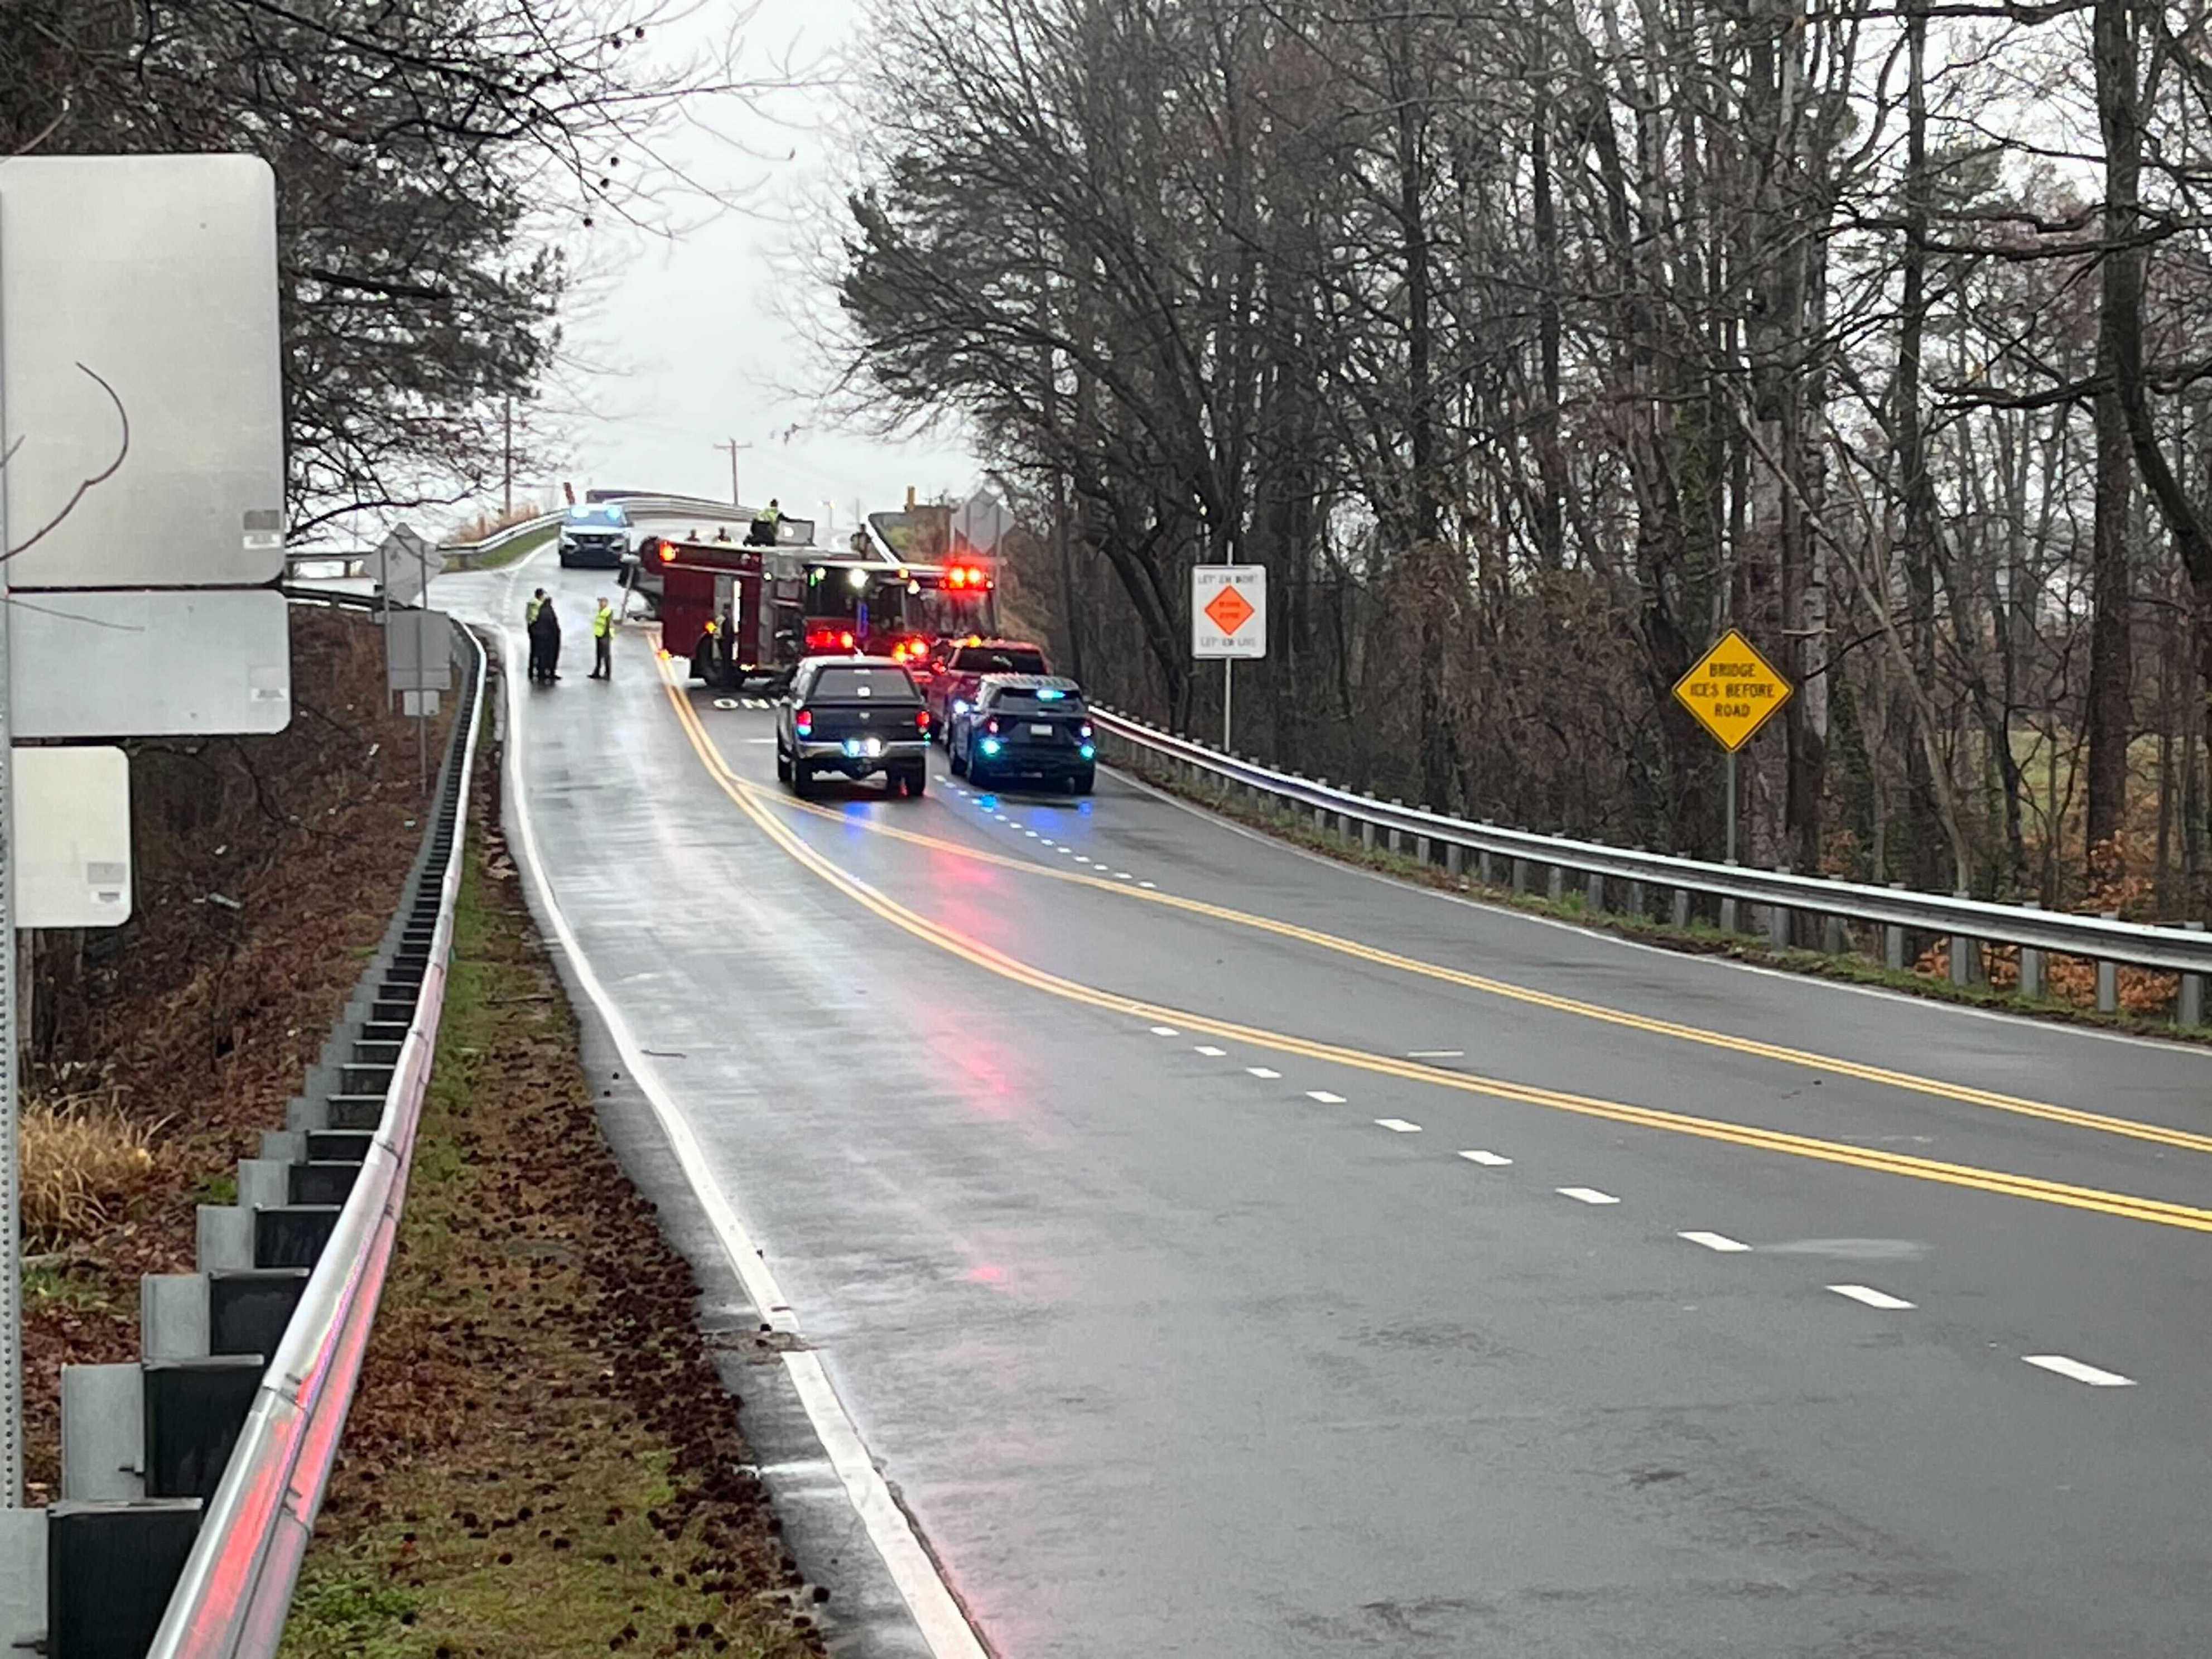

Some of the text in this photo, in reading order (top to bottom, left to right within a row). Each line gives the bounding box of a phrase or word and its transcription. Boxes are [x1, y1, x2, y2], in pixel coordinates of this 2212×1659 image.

[1709, 663, 1756, 677] BRIDGE
[1690, 683, 1775, 698] ICES BEFORE
[1714, 703, 1751, 717] ROAD
